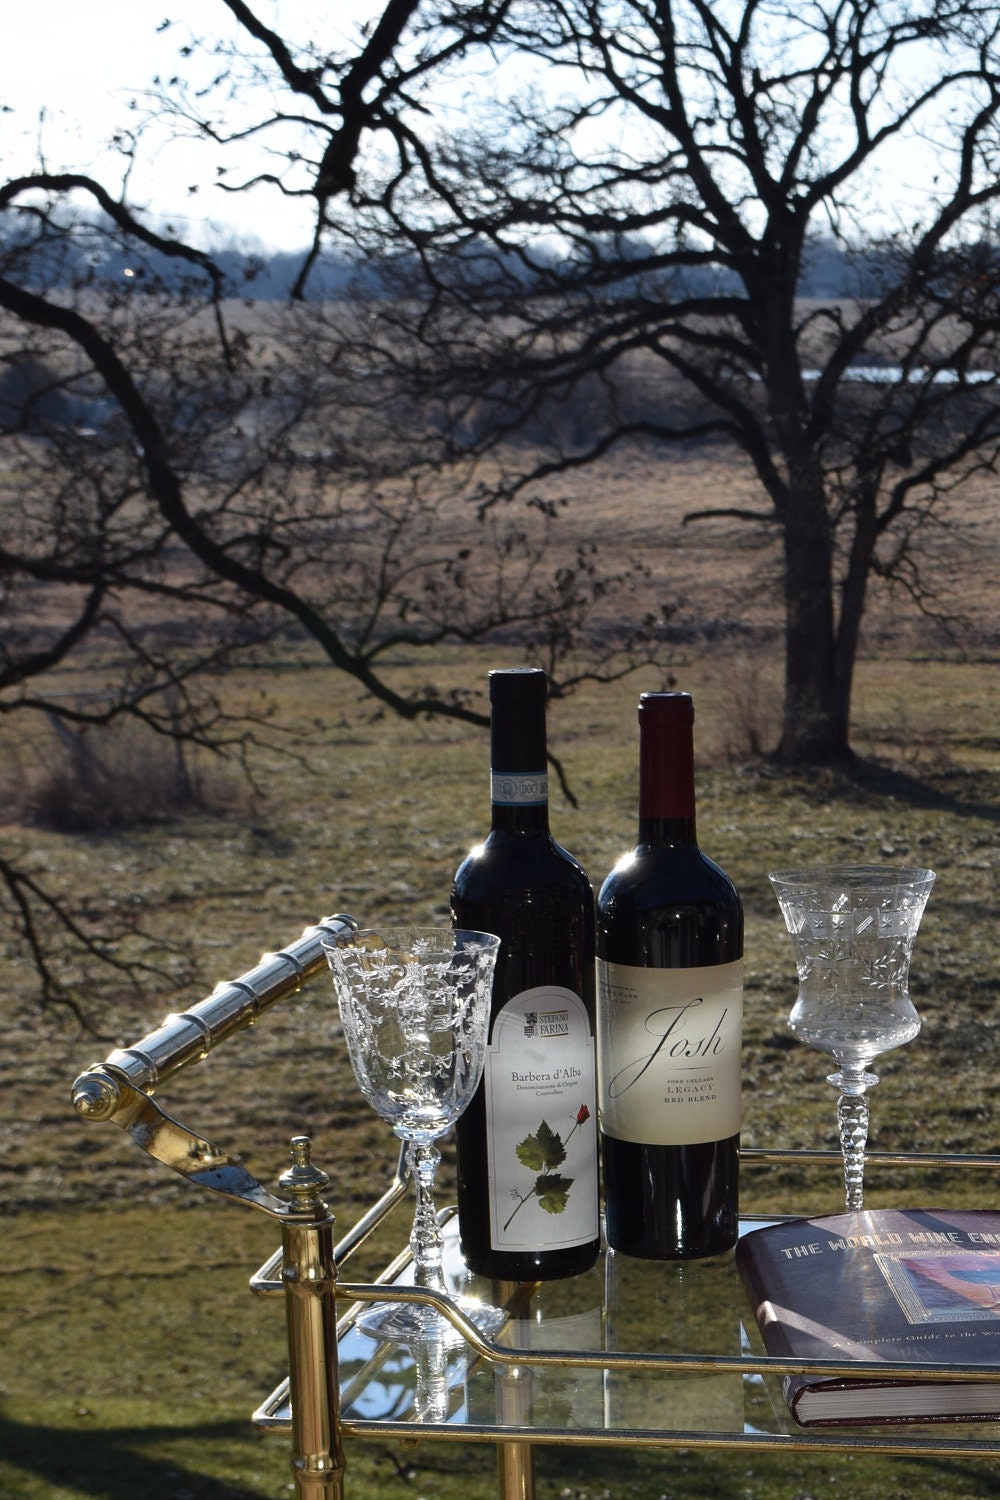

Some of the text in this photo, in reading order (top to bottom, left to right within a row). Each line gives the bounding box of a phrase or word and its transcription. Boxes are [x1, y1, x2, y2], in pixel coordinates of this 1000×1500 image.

[539, 1014, 568, 1024] STEFANO
[540, 1023, 569, 1034] FARINA
[608, 998, 727, 1098] Josh
[511, 1067, 581, 1082] Barbera d'Alba
[667, 1084, 714, 1093] LEGACY
[781, 1243, 823, 1259] THE
[828, 1233, 903, 1251] WORLD
[908, 1232, 963, 1243] WINE
[905, 1333, 941, 1341] Guide
